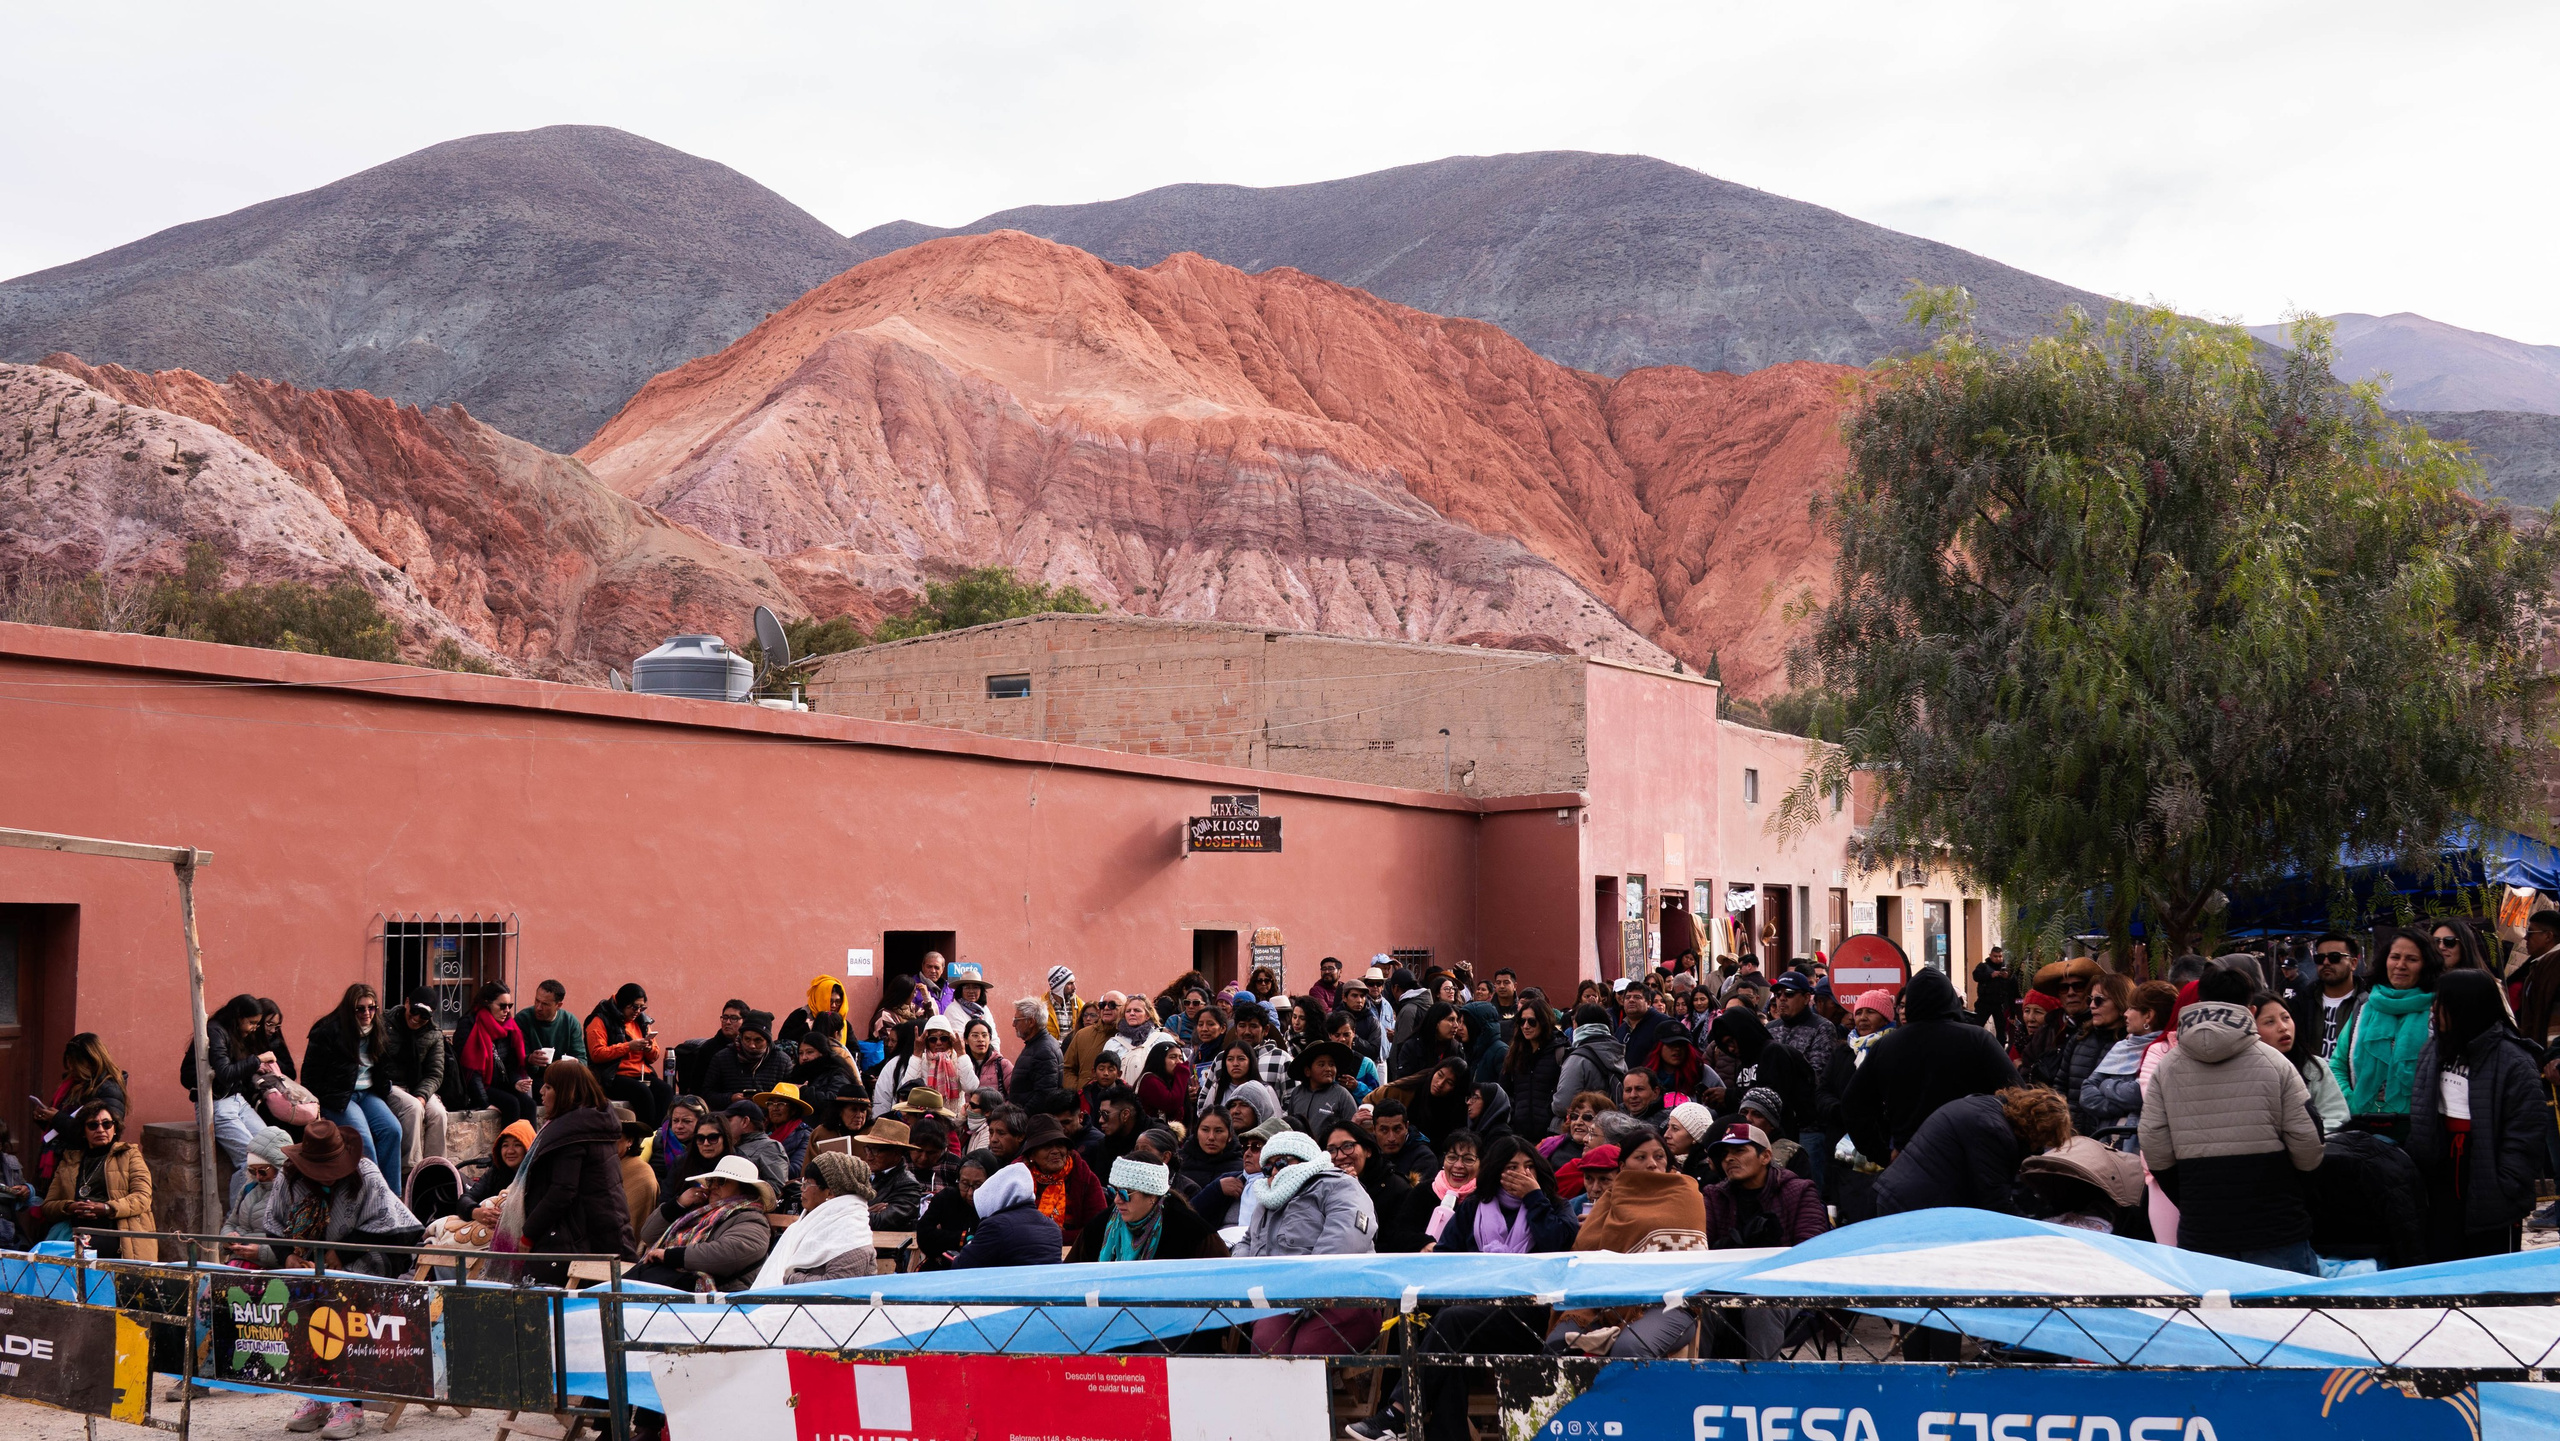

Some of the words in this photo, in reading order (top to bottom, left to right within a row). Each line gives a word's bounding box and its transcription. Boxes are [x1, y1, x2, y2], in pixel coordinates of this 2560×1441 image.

[1212, 820, 1260, 832] KIOSCO
[849, 957, 871, 966] BAÑOS
[232, 1302, 284, 1325] BALUT
[347, 1312, 407, 1342] BVT
[390, 1349, 395, 1360] y
[1097, 1372, 1105, 1381] la
[1106, 1373, 1145, 1383] experiencia
[1088, 1383, 1098, 1392] de
[1098, 1384, 1120, 1393] cuidar
[1121, 1384, 1129, 1394] tu
